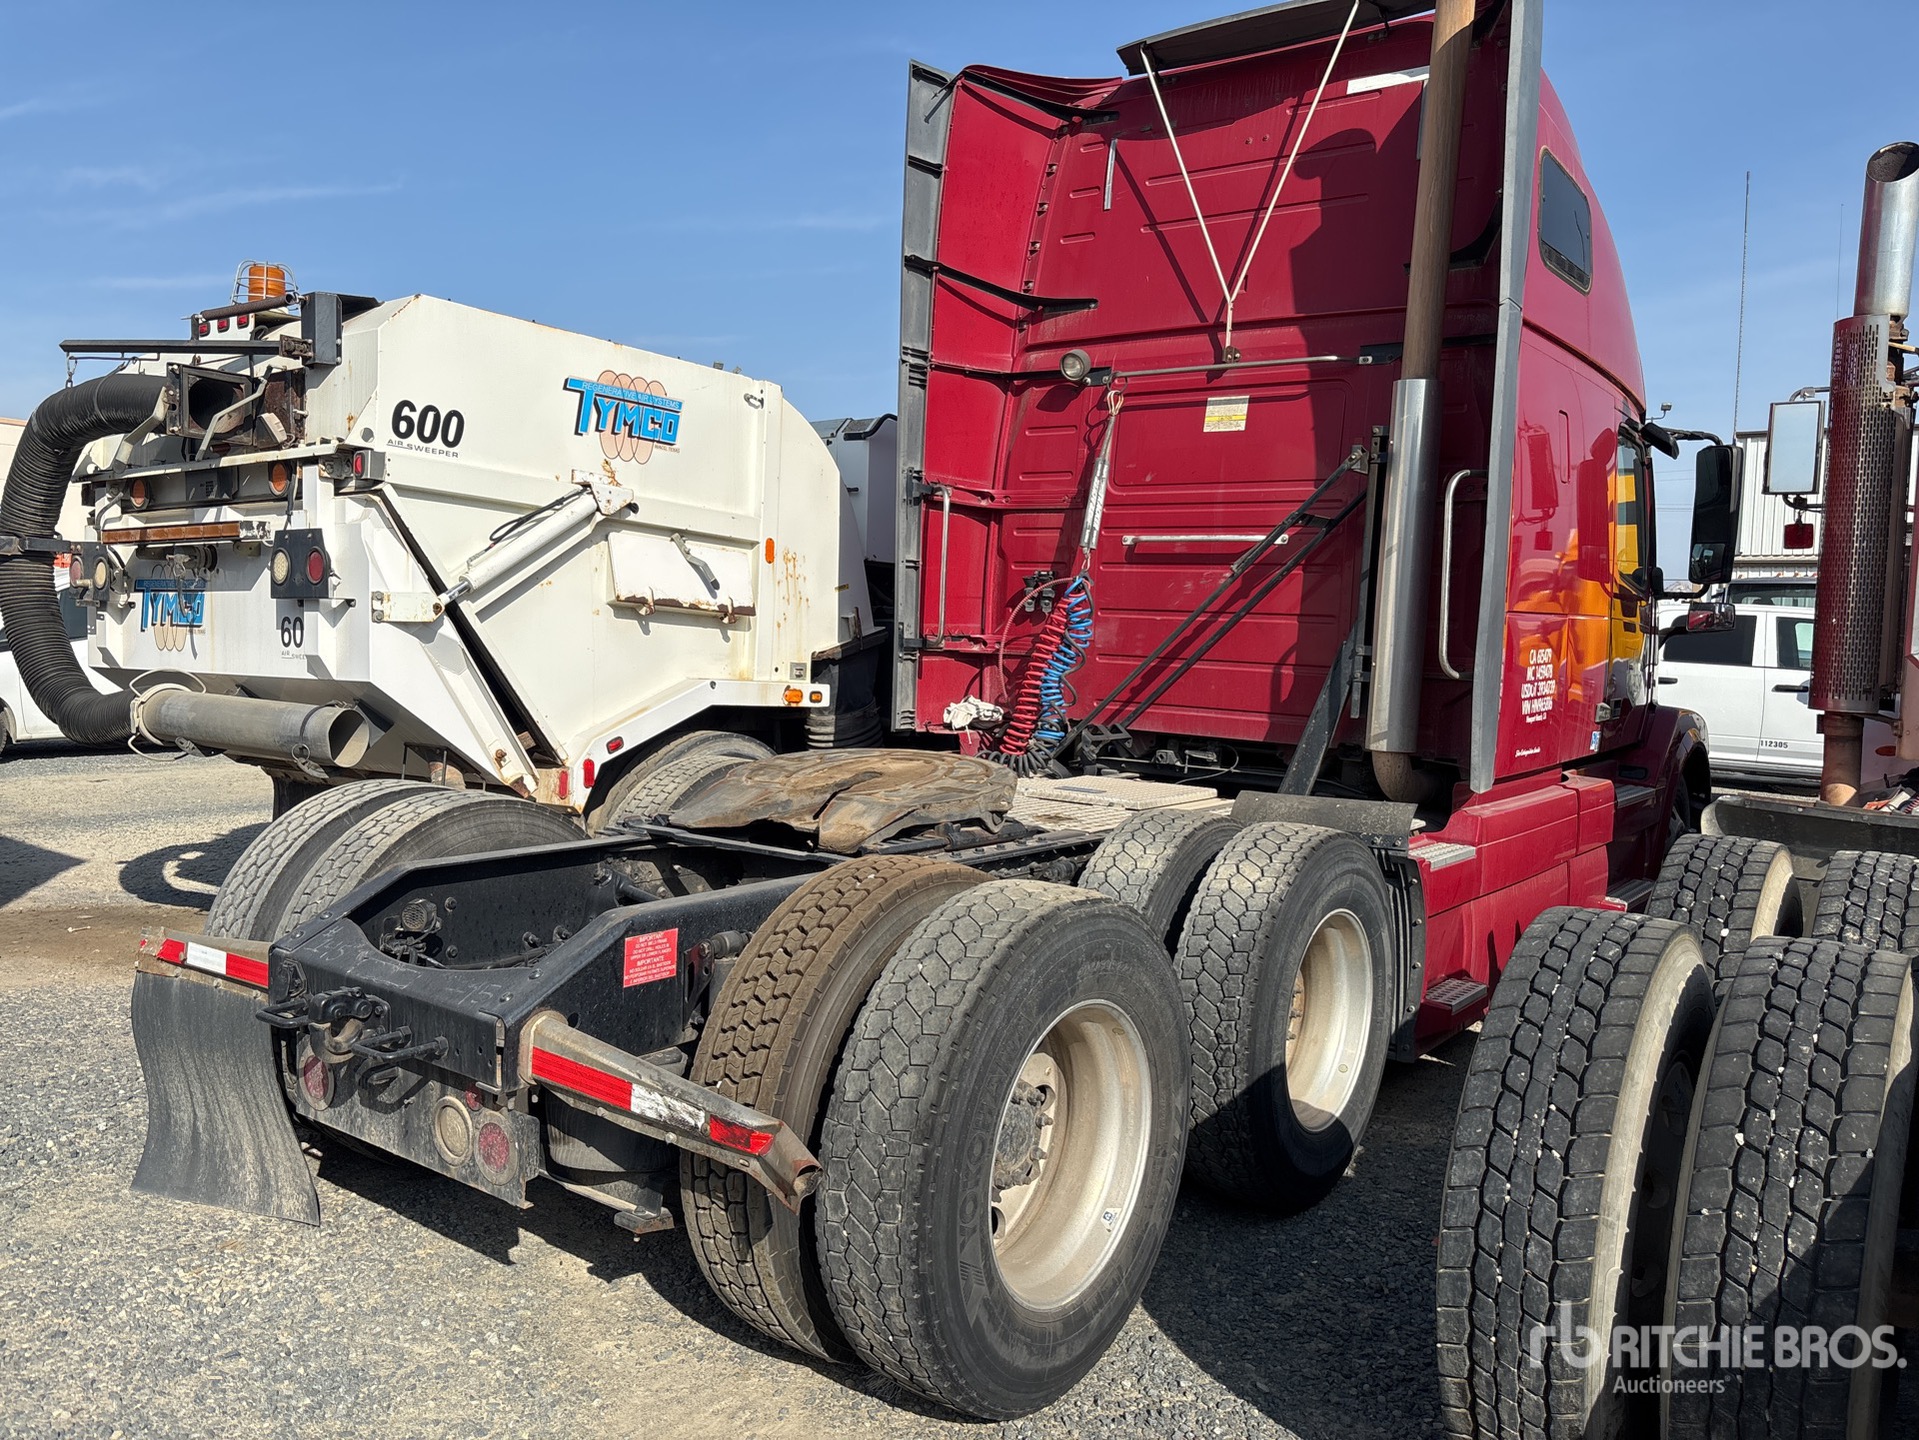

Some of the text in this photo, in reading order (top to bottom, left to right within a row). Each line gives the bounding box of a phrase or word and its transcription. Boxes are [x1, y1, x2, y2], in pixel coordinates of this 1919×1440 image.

[562, 376, 683, 446] TYMCO
[391, 399, 465, 448] 600
[387, 438, 459, 458] AIR SWEEPER
[1529, 649, 1537, 665] CA
[1526, 666, 1535, 681] MC
[1521, 682, 1537, 699] USDOT
[1760, 740, 1788, 749] 112305
[638, 932, 663, 942] IMPORTANT
[636, 955, 664, 966] IMPORTANTE
